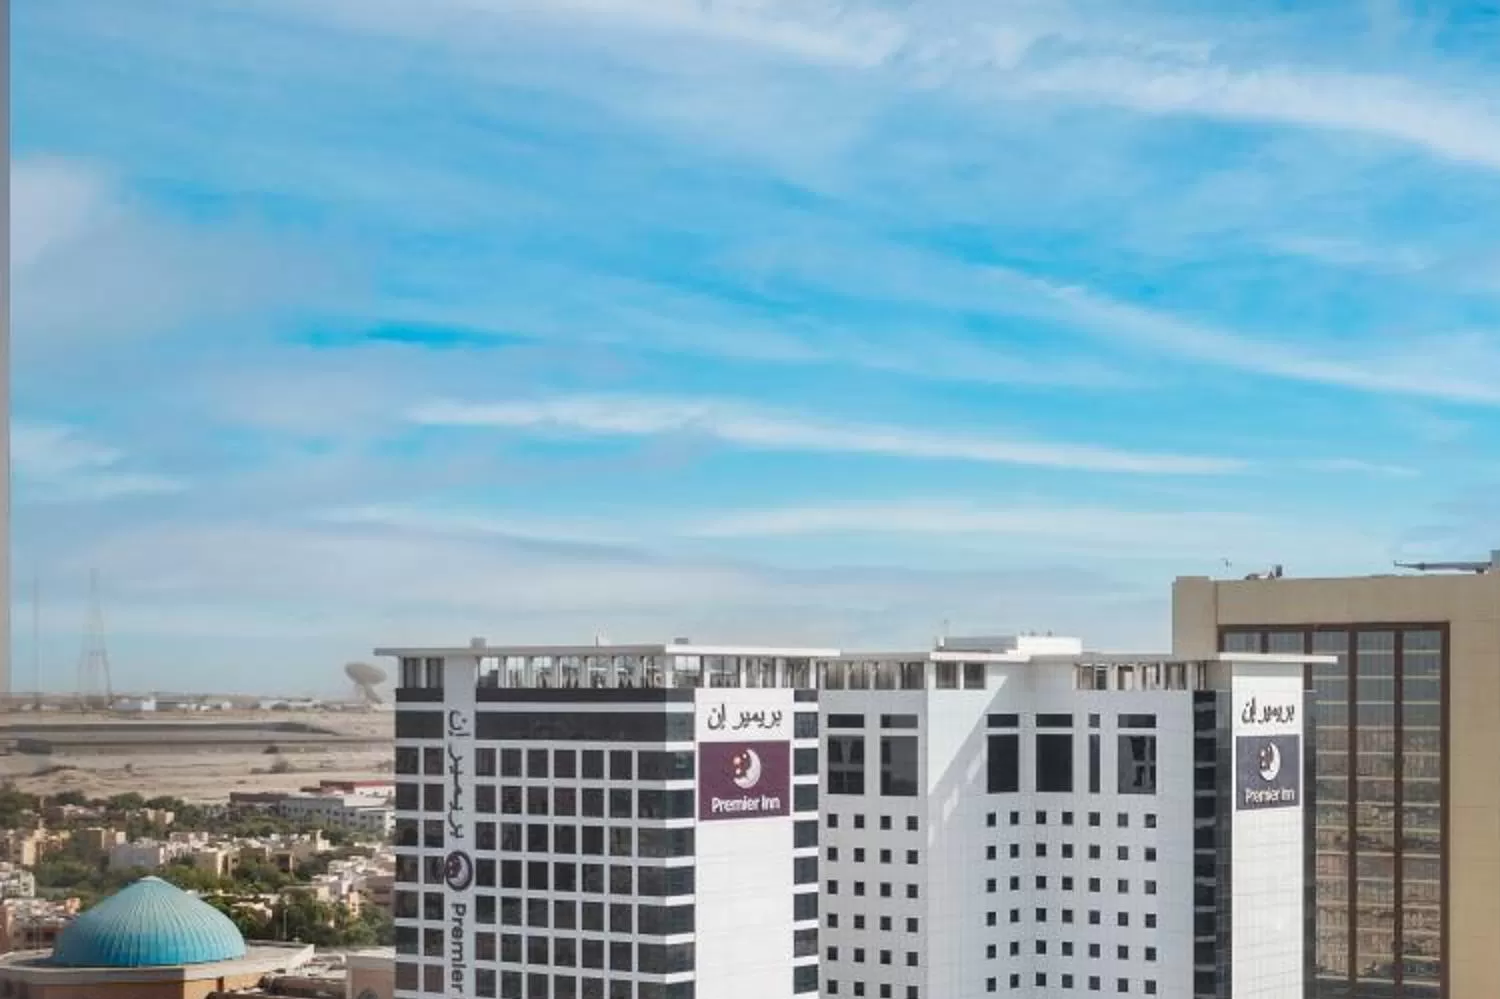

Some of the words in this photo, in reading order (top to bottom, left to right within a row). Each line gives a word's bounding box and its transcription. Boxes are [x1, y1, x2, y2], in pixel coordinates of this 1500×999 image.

[711, 795, 760, 813] Premier
[761, 794, 781, 811] Inn
[450, 903, 468, 993] Premier
